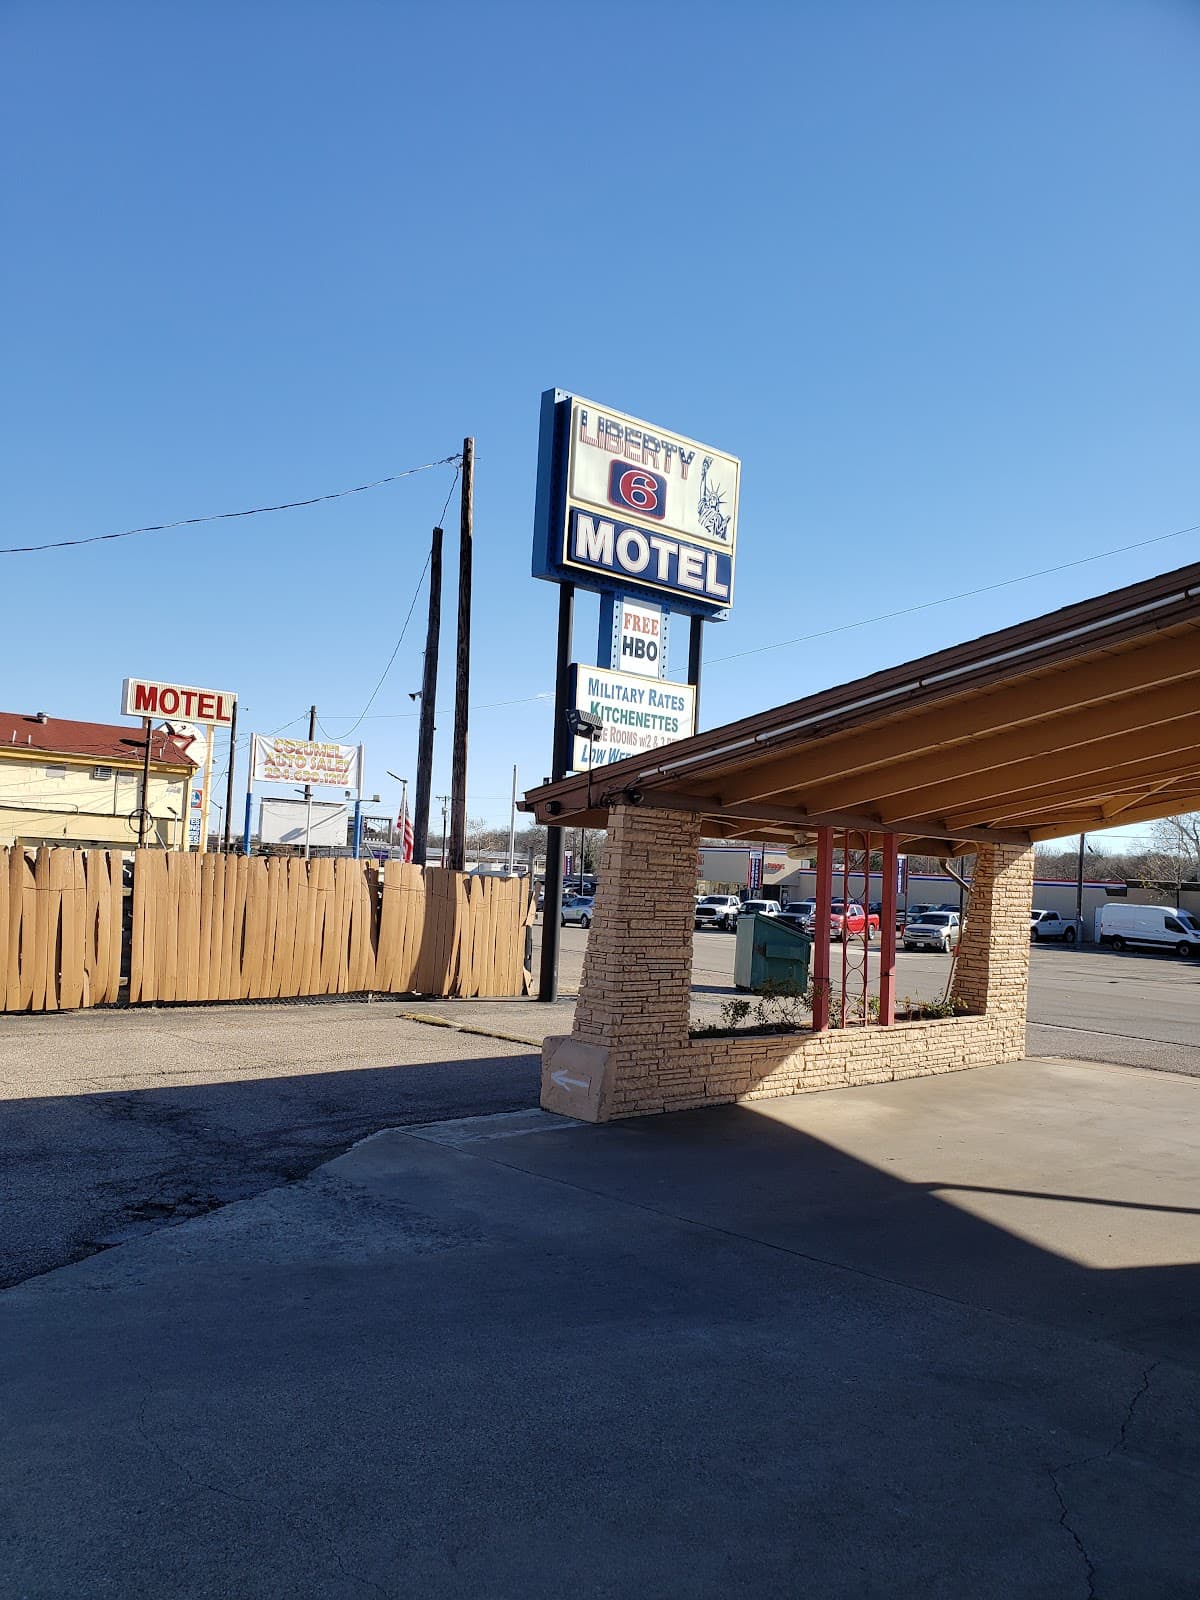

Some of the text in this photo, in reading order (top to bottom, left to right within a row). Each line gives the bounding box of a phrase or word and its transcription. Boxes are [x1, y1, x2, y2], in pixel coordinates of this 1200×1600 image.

[581, 409, 695, 480] LIBERTY
[619, 469, 659, 511] 6
[576, 513, 729, 598] MOTEL
[623, 612, 660, 637] FREE
[622, 635, 658, 662] HBO
[135, 684, 231, 722] MOTEL
[588, 677, 685, 712] MILITARY RATES
[590, 700, 679, 733] KITCHENETTES
[274, 738, 344, 760] COZUMEL
[609, 726, 638, 747] ROOMS
[264, 752, 351, 774] AUTO SALES
[580, 743, 607, 764] LOW
